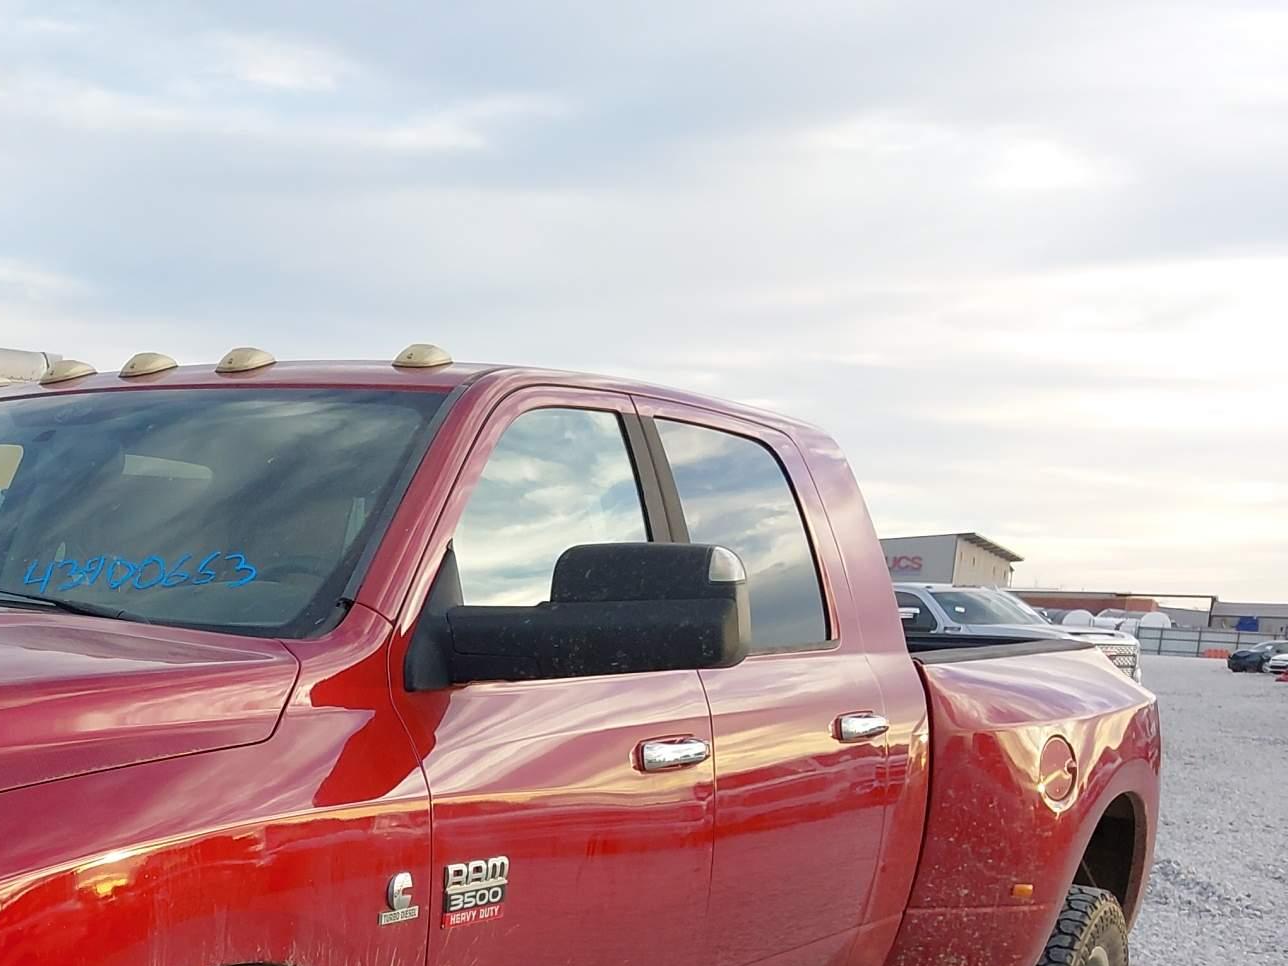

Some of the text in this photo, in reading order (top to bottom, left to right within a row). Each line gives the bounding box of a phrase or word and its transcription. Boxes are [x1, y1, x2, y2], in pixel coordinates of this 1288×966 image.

[446, 856, 510, 890] RAM
[449, 887, 503, 912] 3500
[450, 905, 500, 925] HEAVY DUTY
